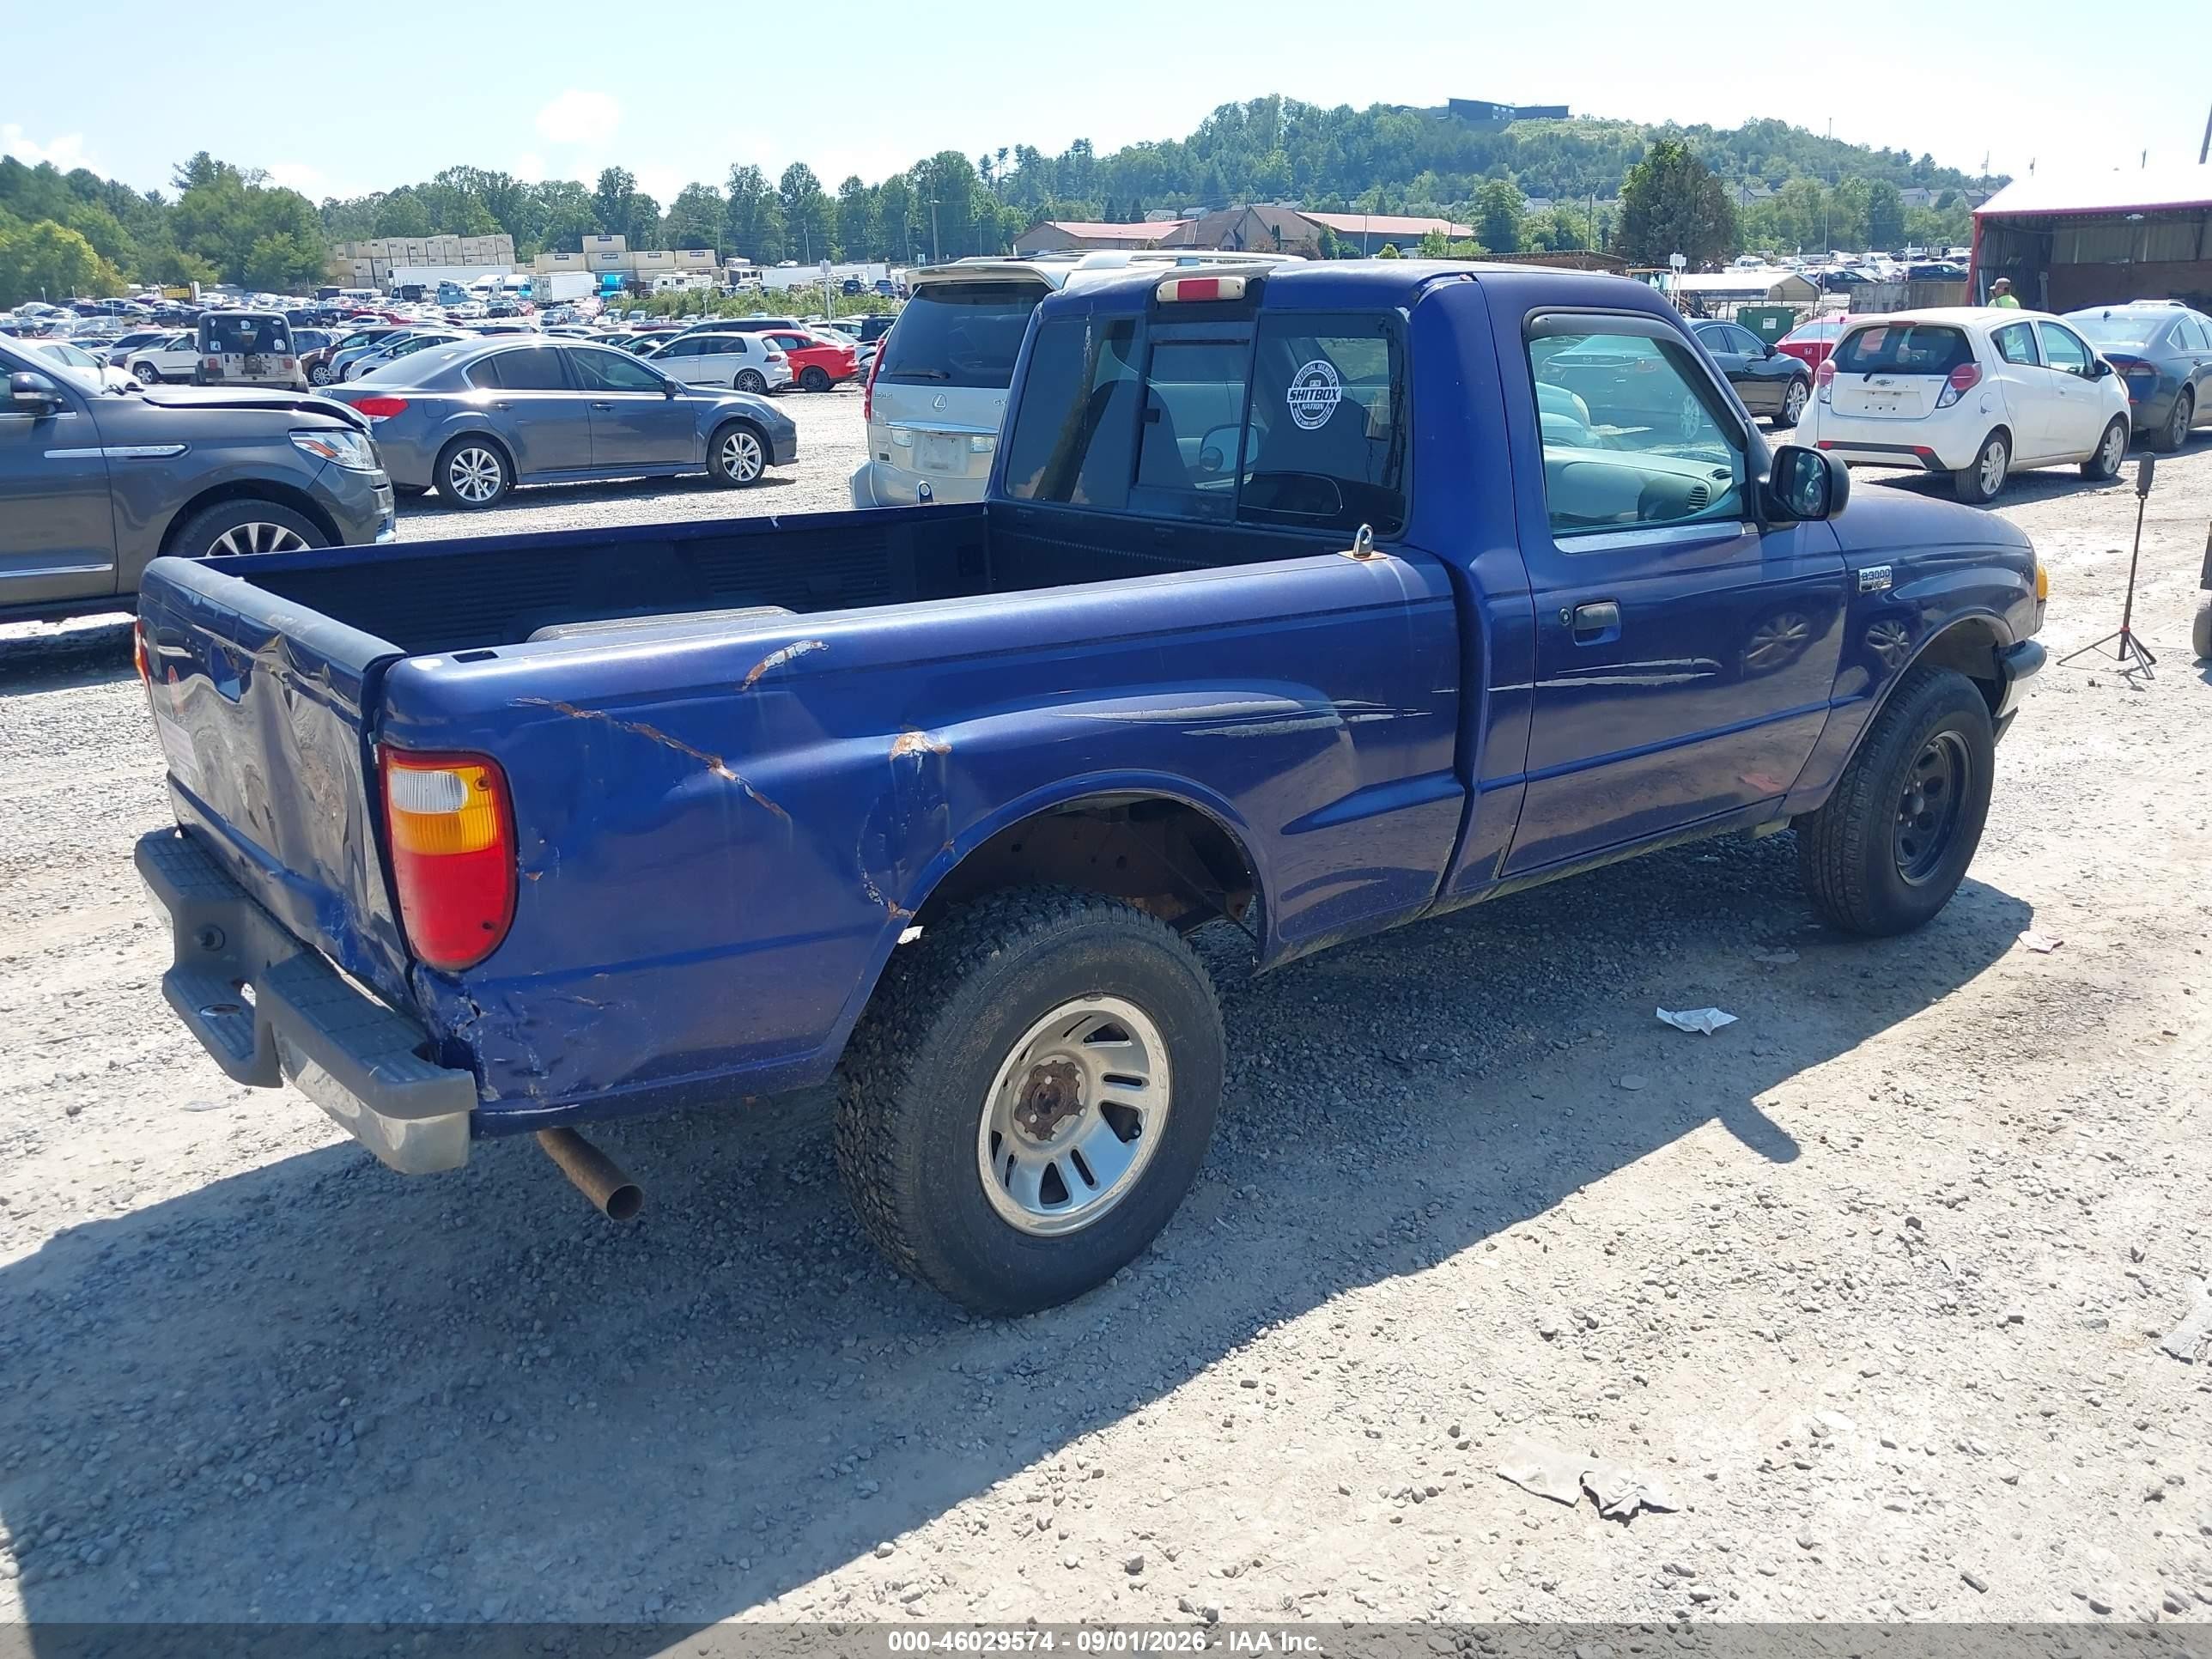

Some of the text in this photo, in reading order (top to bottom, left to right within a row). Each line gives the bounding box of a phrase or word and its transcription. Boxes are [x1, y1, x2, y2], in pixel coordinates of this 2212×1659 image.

[1296, 364, 1336, 386] OFFICIAL MEMBER
[1289, 388, 1340, 401] SHITBOX
